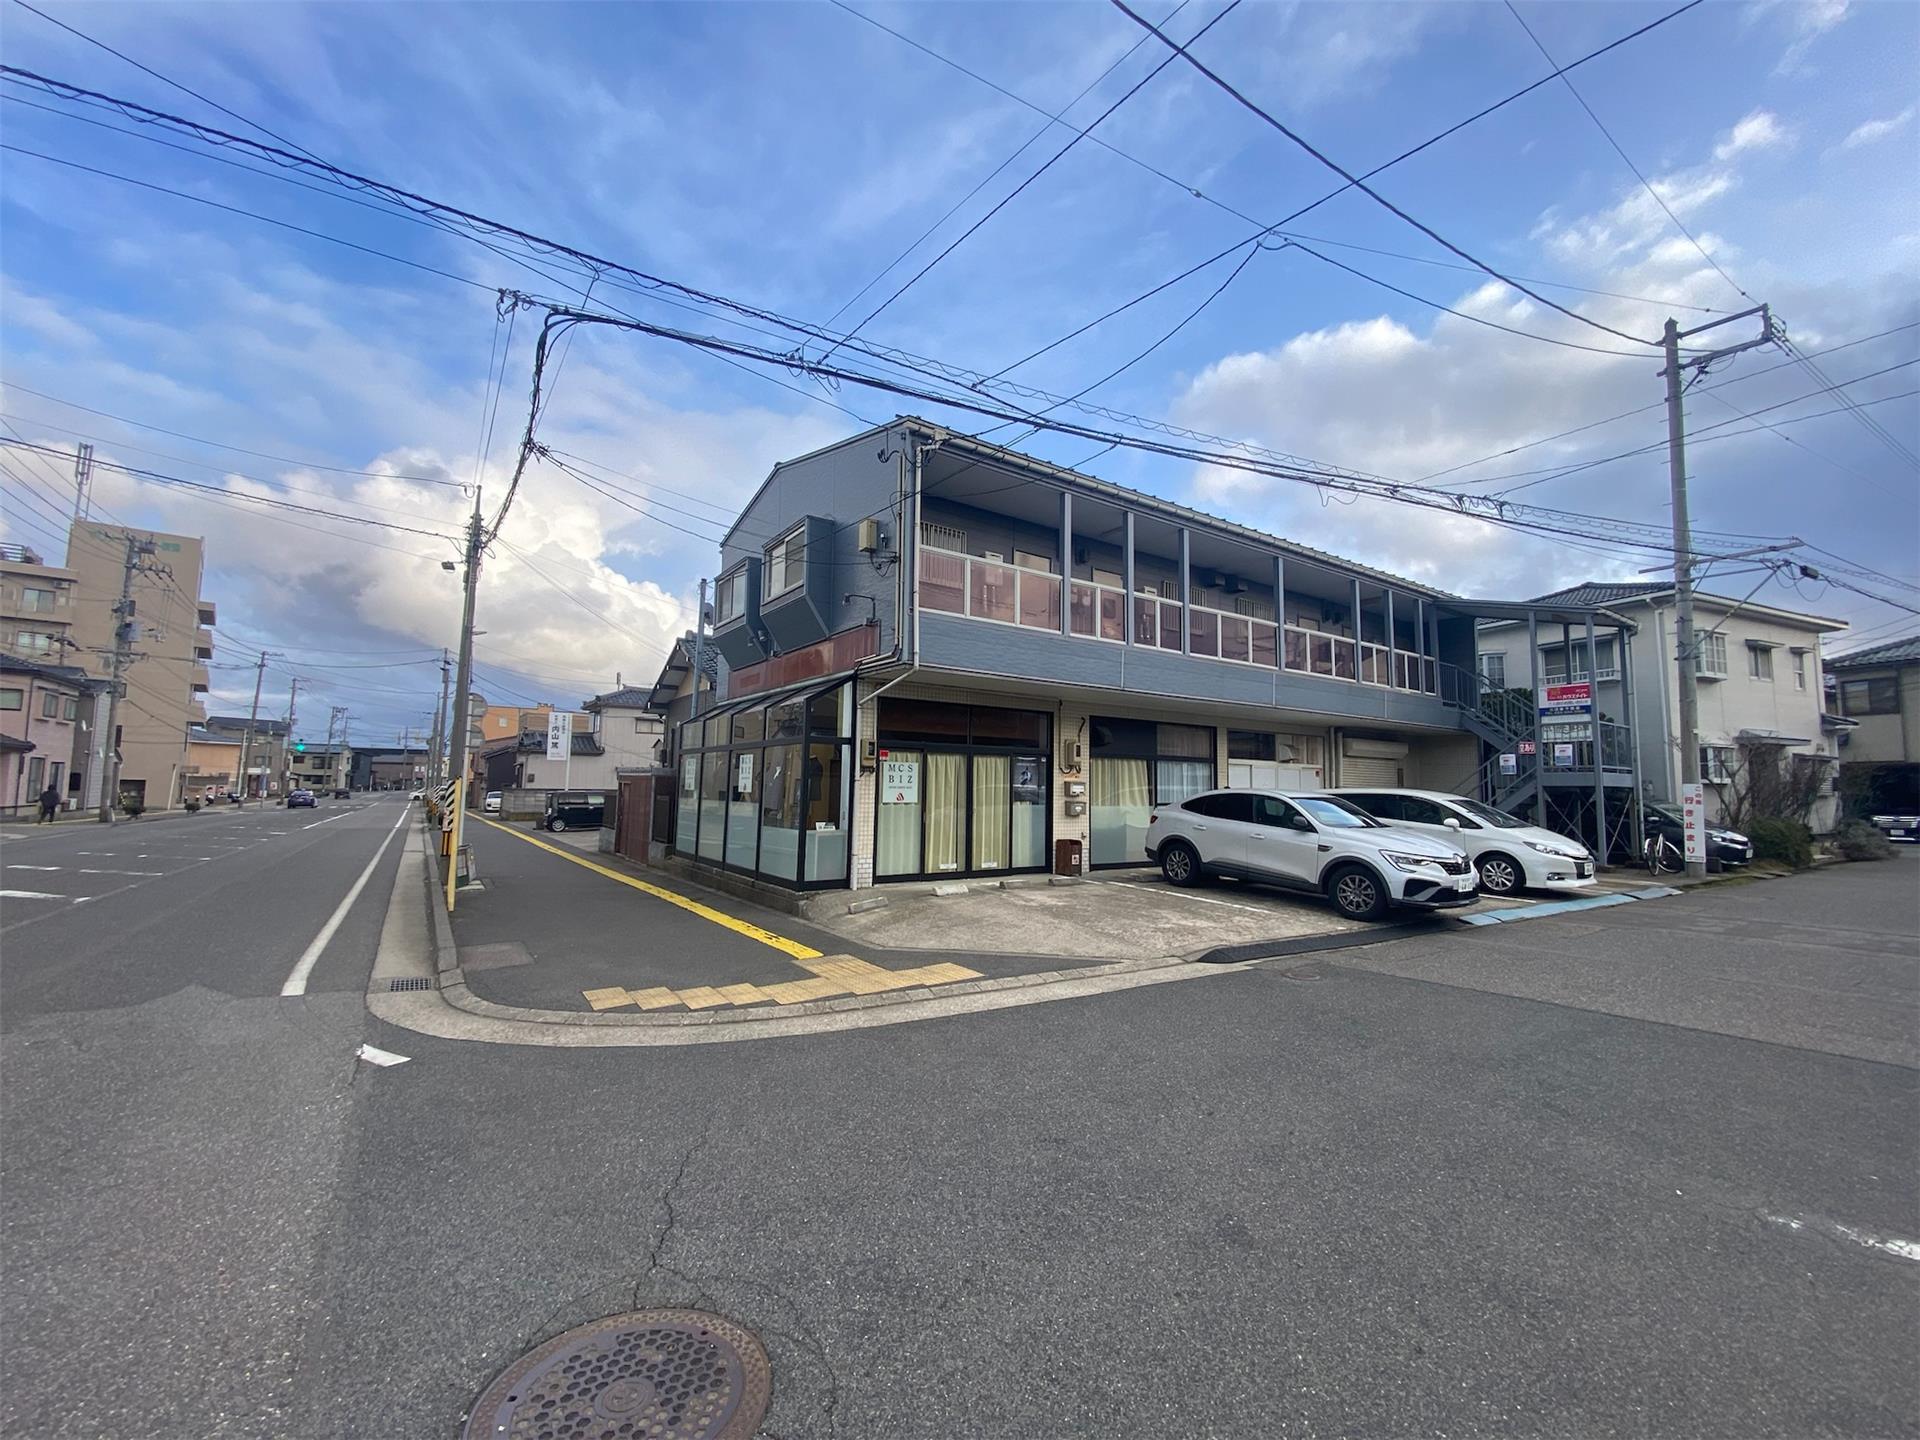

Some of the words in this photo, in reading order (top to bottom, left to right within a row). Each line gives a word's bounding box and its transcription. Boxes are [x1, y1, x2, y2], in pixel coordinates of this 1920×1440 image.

[888, 764, 913, 772] MCS
[888, 775, 913, 783] BIZ
[1684, 796, 1696, 854] 行き止まり
